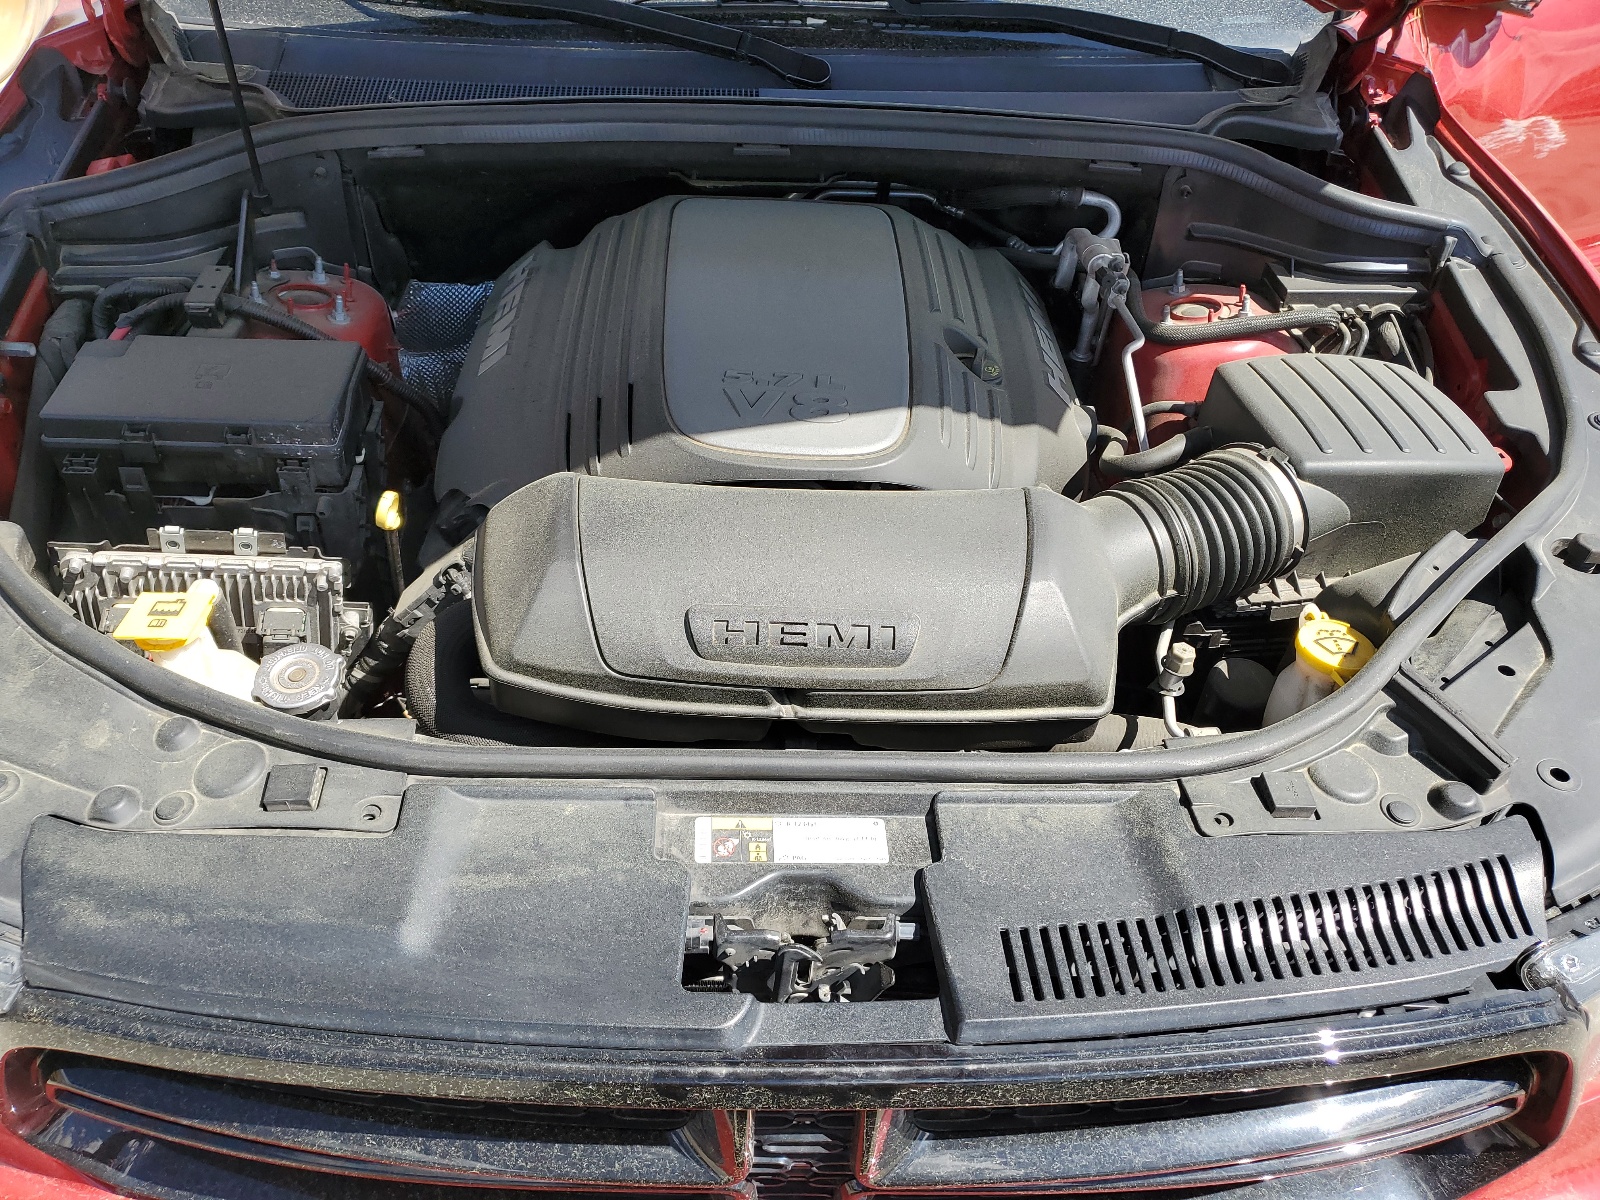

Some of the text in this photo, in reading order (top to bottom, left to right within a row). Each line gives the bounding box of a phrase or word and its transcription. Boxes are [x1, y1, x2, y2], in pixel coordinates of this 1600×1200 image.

[478, 253, 535, 376] HEMI
[1019, 277, 1072, 408] HEMI
[722, 388, 850, 424] V8
[712, 620, 896, 651] HEMI
